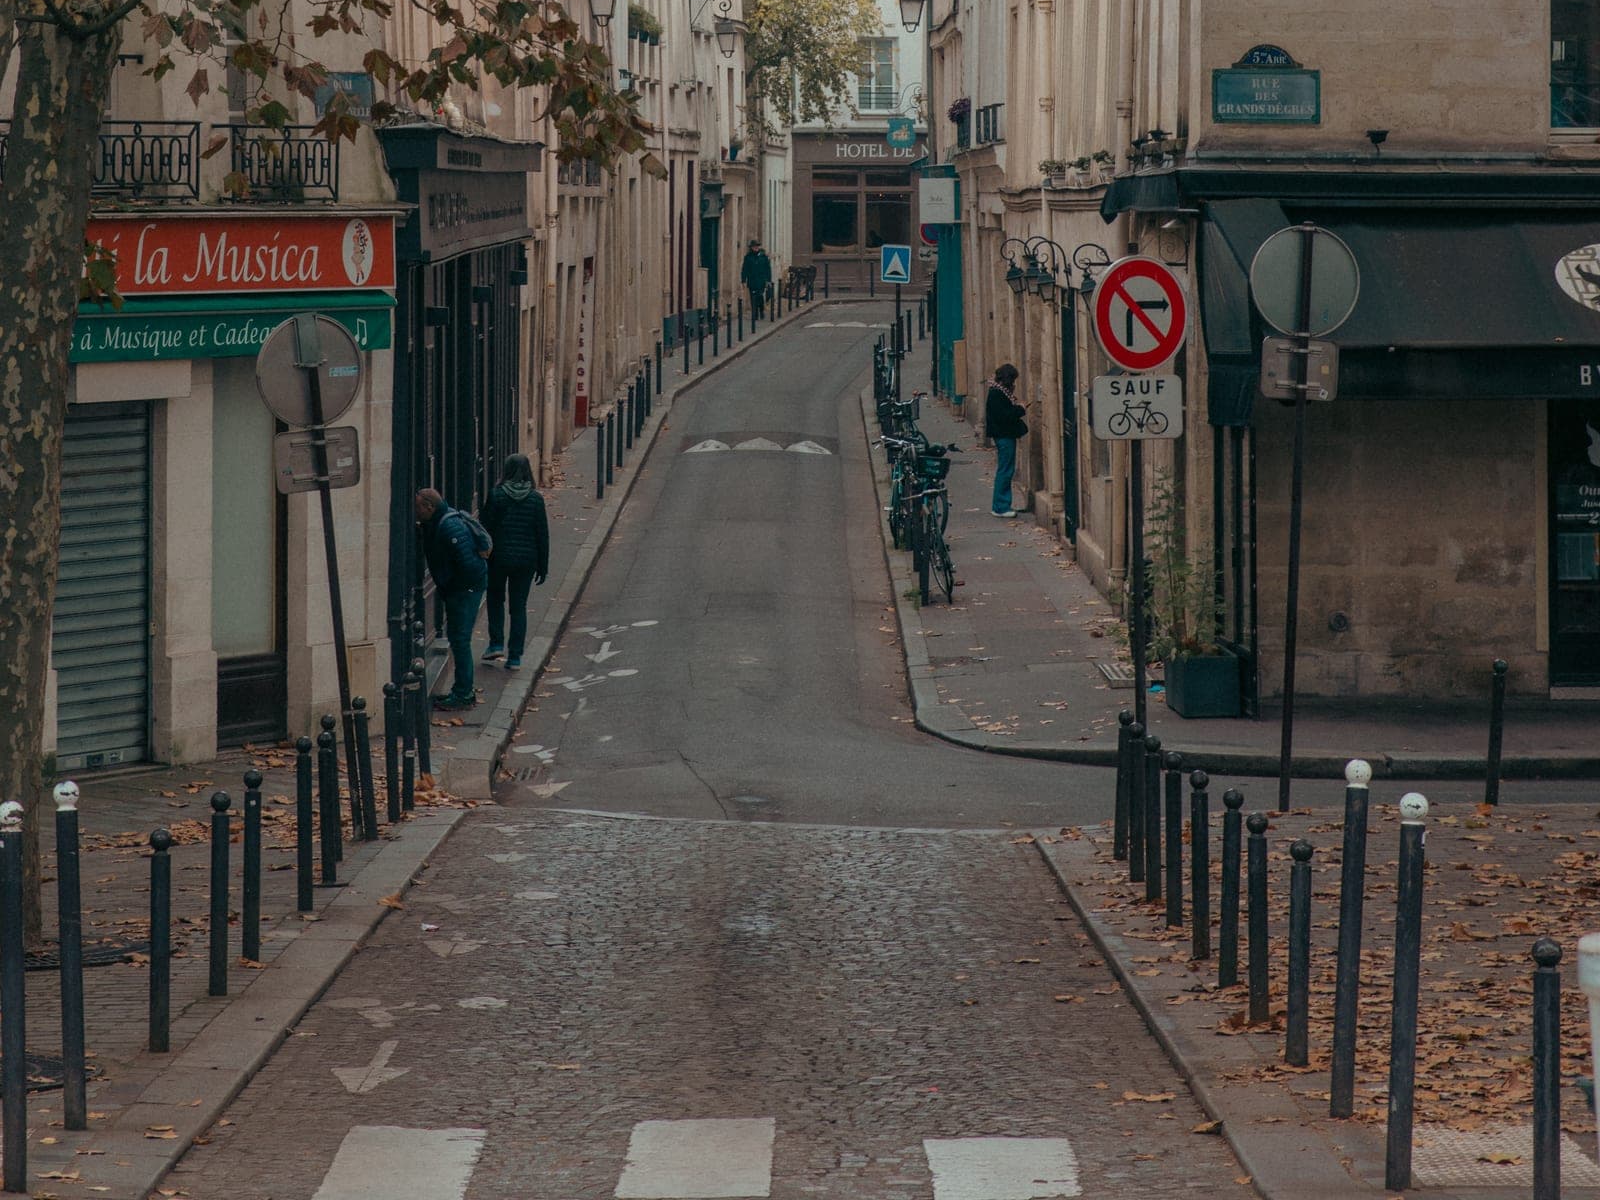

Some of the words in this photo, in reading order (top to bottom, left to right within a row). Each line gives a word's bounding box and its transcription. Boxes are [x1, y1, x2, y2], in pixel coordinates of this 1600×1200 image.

[1252, 78, 1280, 89] RUE
[1255, 92, 1278, 101] DES
[1218, 104, 1265, 114] GRANDS
[836, 143, 889, 158] HOTEL
[134, 223, 173, 286] la
[183, 231, 322, 282] Musica
[80, 325, 93, 350] à
[99, 324, 182, 356] Musique
[189, 327, 207, 346] et
[213, 319, 277, 346] Cadea
[1110, 380, 1165, 396] SAUF
